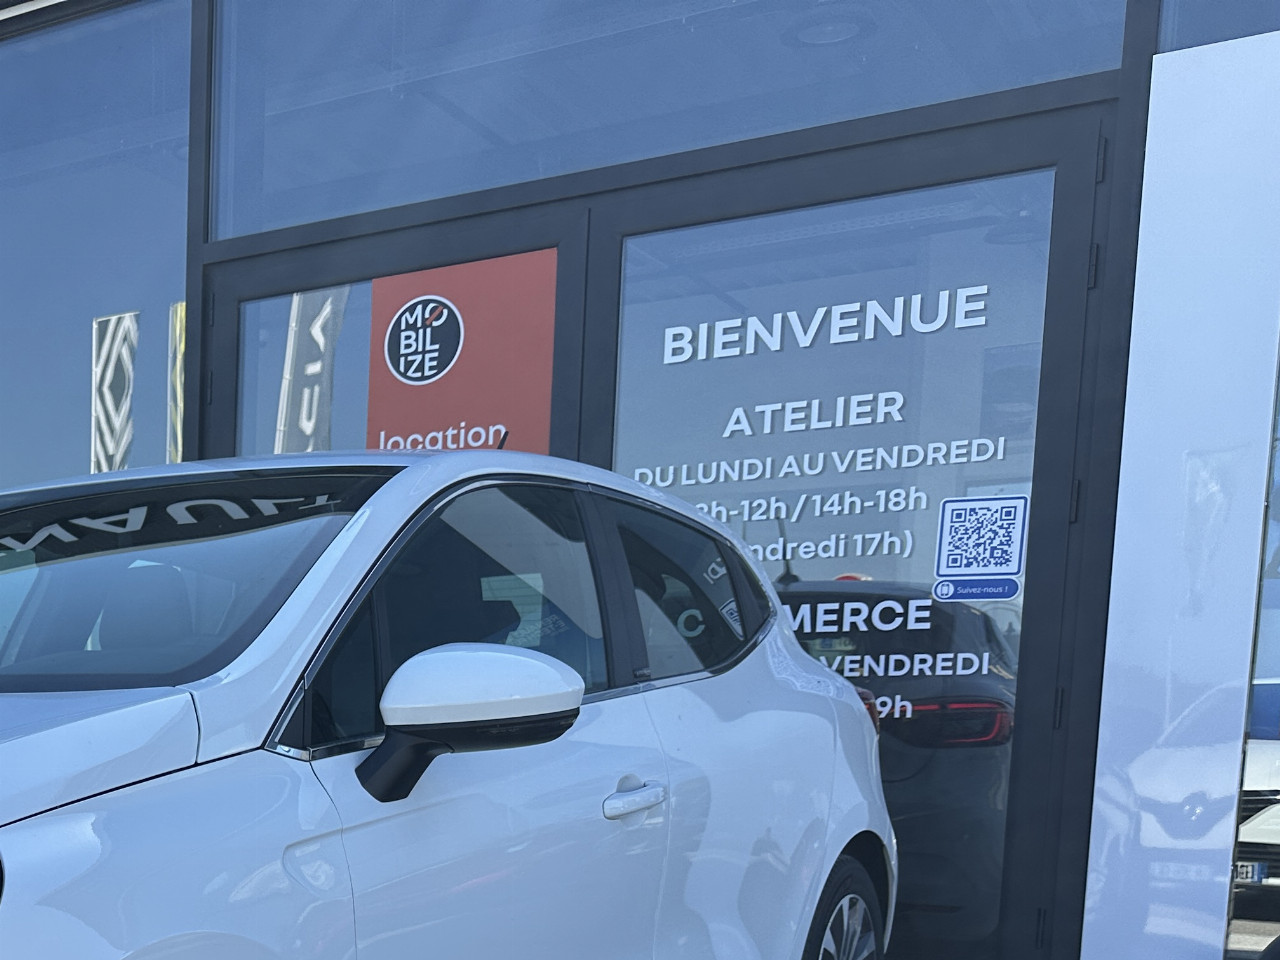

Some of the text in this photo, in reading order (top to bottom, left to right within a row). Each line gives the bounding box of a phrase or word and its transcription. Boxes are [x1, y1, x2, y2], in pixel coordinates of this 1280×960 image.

[663, 284, 988, 365] BIENVENUE
[400, 327, 440, 354] BIL
[399, 352, 439, 378] IZE
[722, 391, 905, 438] ATELIER
[380, 422, 507, 450] location
[634, 437, 1006, 488] DU LUNDI AU VENDREDI
[748, 530, 914, 562] ndredi 17h)
[955, 585, 1003, 595] Suivez-nous
[782, 599, 933, 634] MERCE
[819, 652, 990, 678] VENDREDI
[875, 694, 913, 718] 9h
